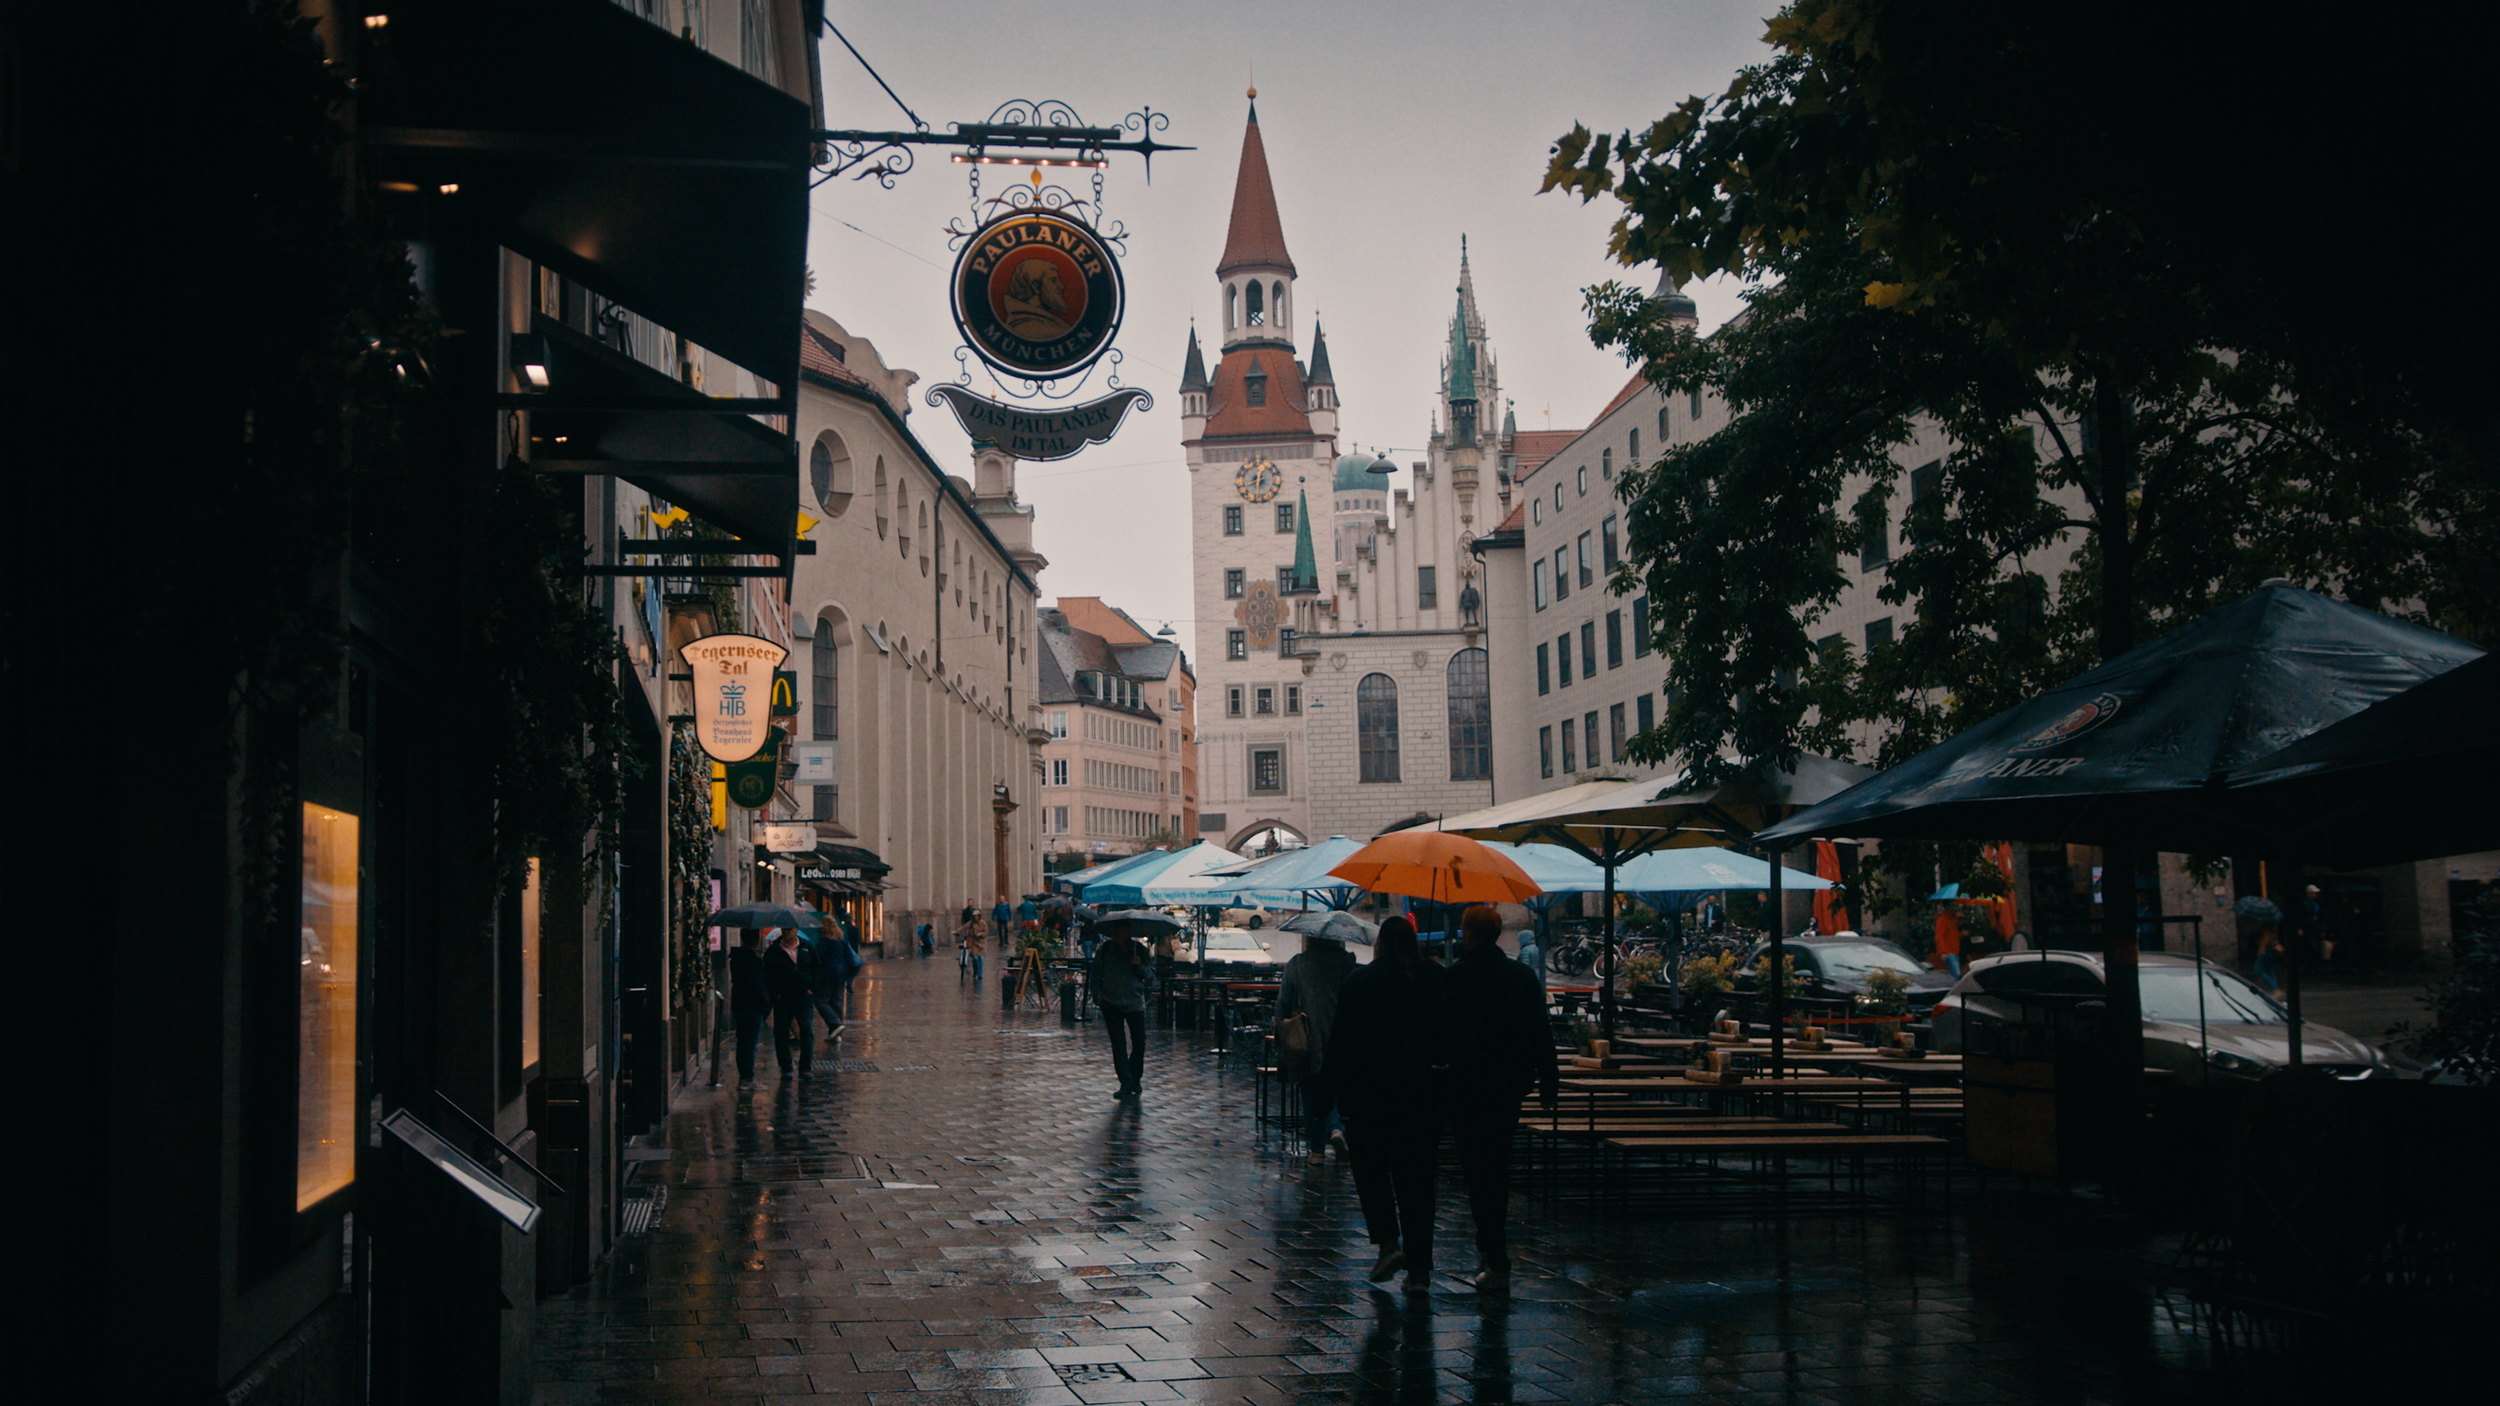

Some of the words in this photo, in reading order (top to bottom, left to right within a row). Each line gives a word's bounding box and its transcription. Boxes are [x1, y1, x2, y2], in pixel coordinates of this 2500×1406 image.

[972, 224, 1102, 278] PAULANER
[983, 323, 1093, 361] MÜNCHEN
[969, 402, 1006, 427] DAS
[1011, 406, 1112, 433] PAULANER
[1011, 435, 1034, 451] IM
[1036, 436, 1071, 452] TAL
[689, 643, 779, 662] Tegernseer
[719, 660, 748, 675] Tal
[713, 735, 752, 745] Tegernsee
